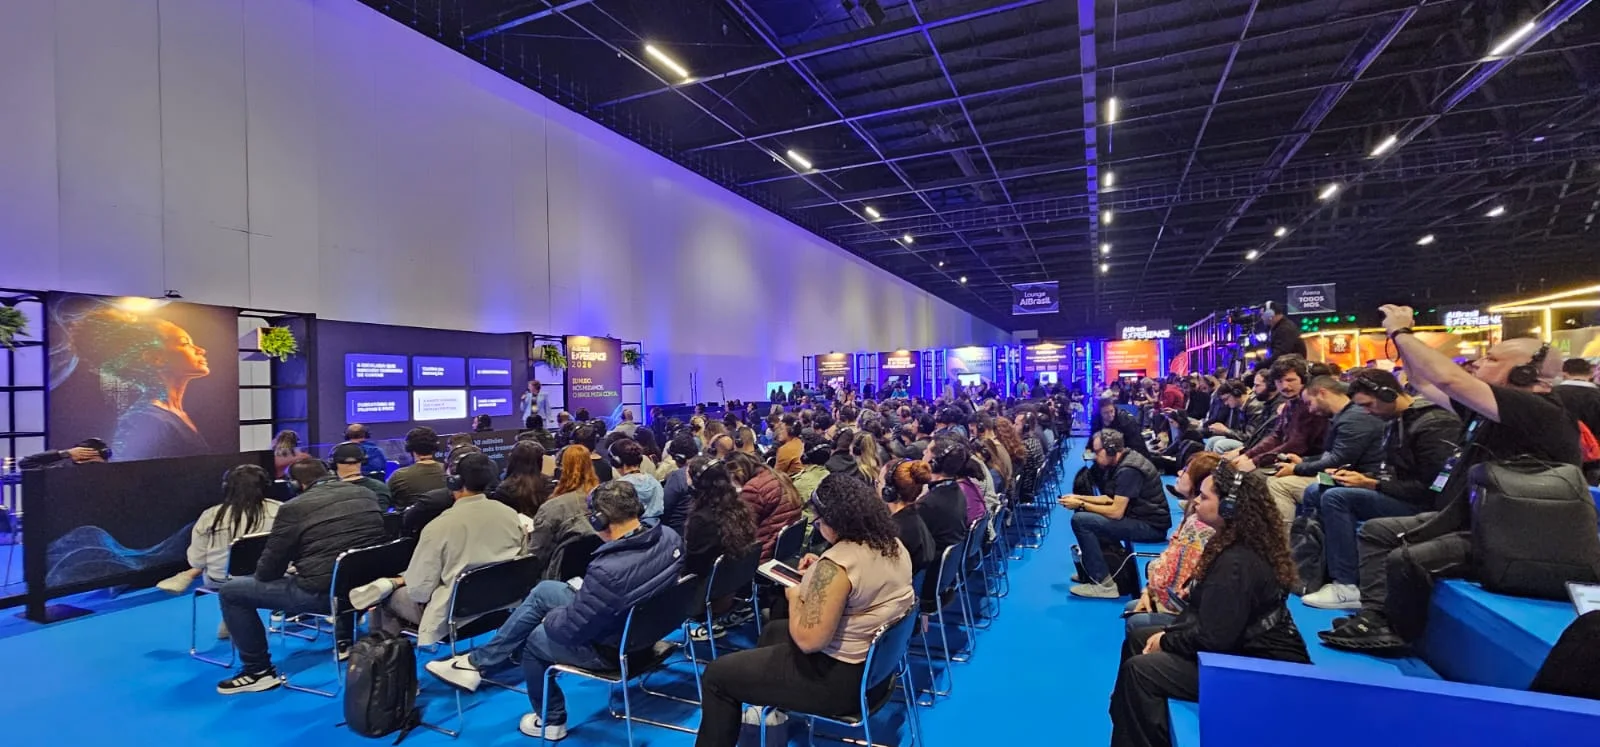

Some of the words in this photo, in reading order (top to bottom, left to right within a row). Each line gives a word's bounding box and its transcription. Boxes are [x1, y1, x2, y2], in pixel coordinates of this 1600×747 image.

[1024, 291, 1046, 299] Lounge
[1299, 295, 1325, 303] TODOS
[1019, 297, 1051, 305] AIBrasil
